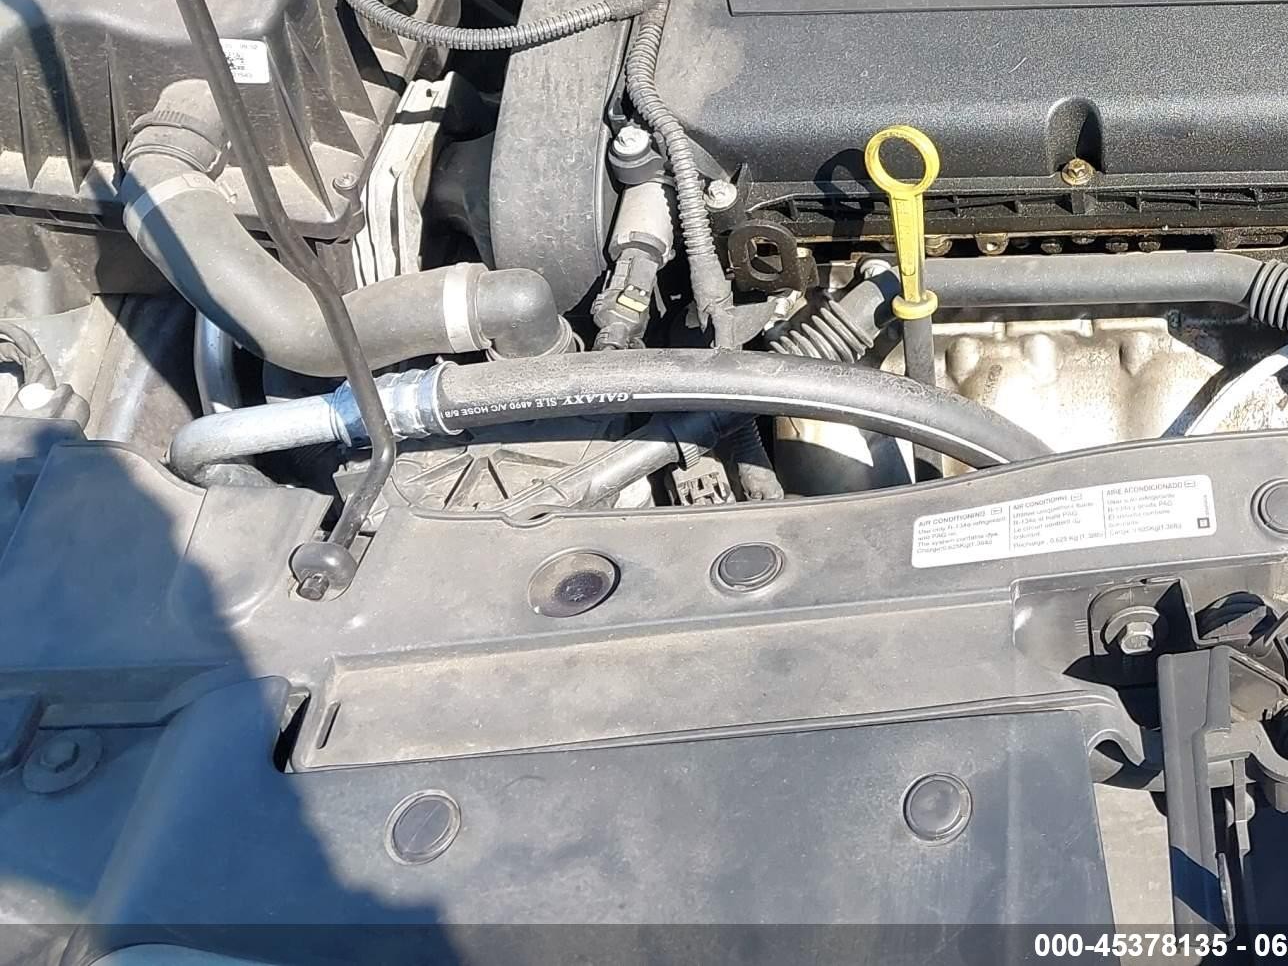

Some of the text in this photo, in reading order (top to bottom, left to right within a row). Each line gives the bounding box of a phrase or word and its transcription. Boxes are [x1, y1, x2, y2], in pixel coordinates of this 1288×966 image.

[536, 398, 558, 408] SLE
[563, 393, 629, 405] GALAXY
[461, 406, 489, 416] HOSE
[490, 403, 507, 412] A/C
